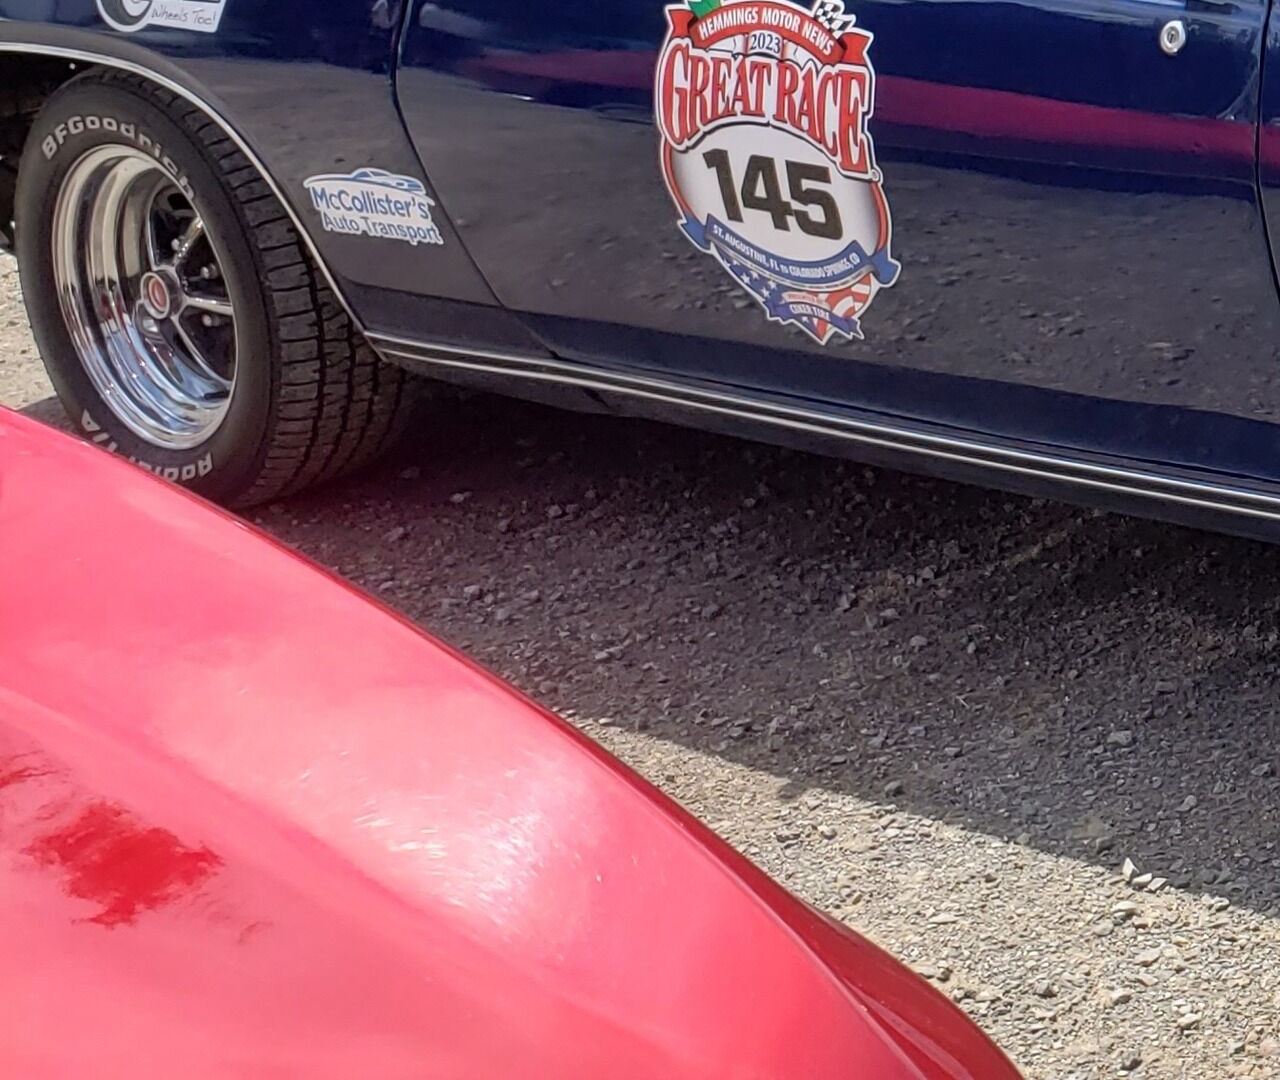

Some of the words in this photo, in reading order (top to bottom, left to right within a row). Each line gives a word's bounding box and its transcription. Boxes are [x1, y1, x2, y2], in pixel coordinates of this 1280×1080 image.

[151, 4, 188, 22] Wheels
[699, 6, 759, 41] HEMMINGS
[761, 7, 801, 34] MOTOR
[801, 22, 834, 56] NEWS
[750, 31, 781, 54] 2023
[662, 43, 772, 146] GREAT
[773, 59, 870, 174] RACE
[41, 115, 195, 200] BFGoodrich
[311, 186, 430, 220] McCollister's
[703, 148, 844, 241] 145
[322, 211, 360, 232] Auto
[360, 216, 440, 242] Transport
